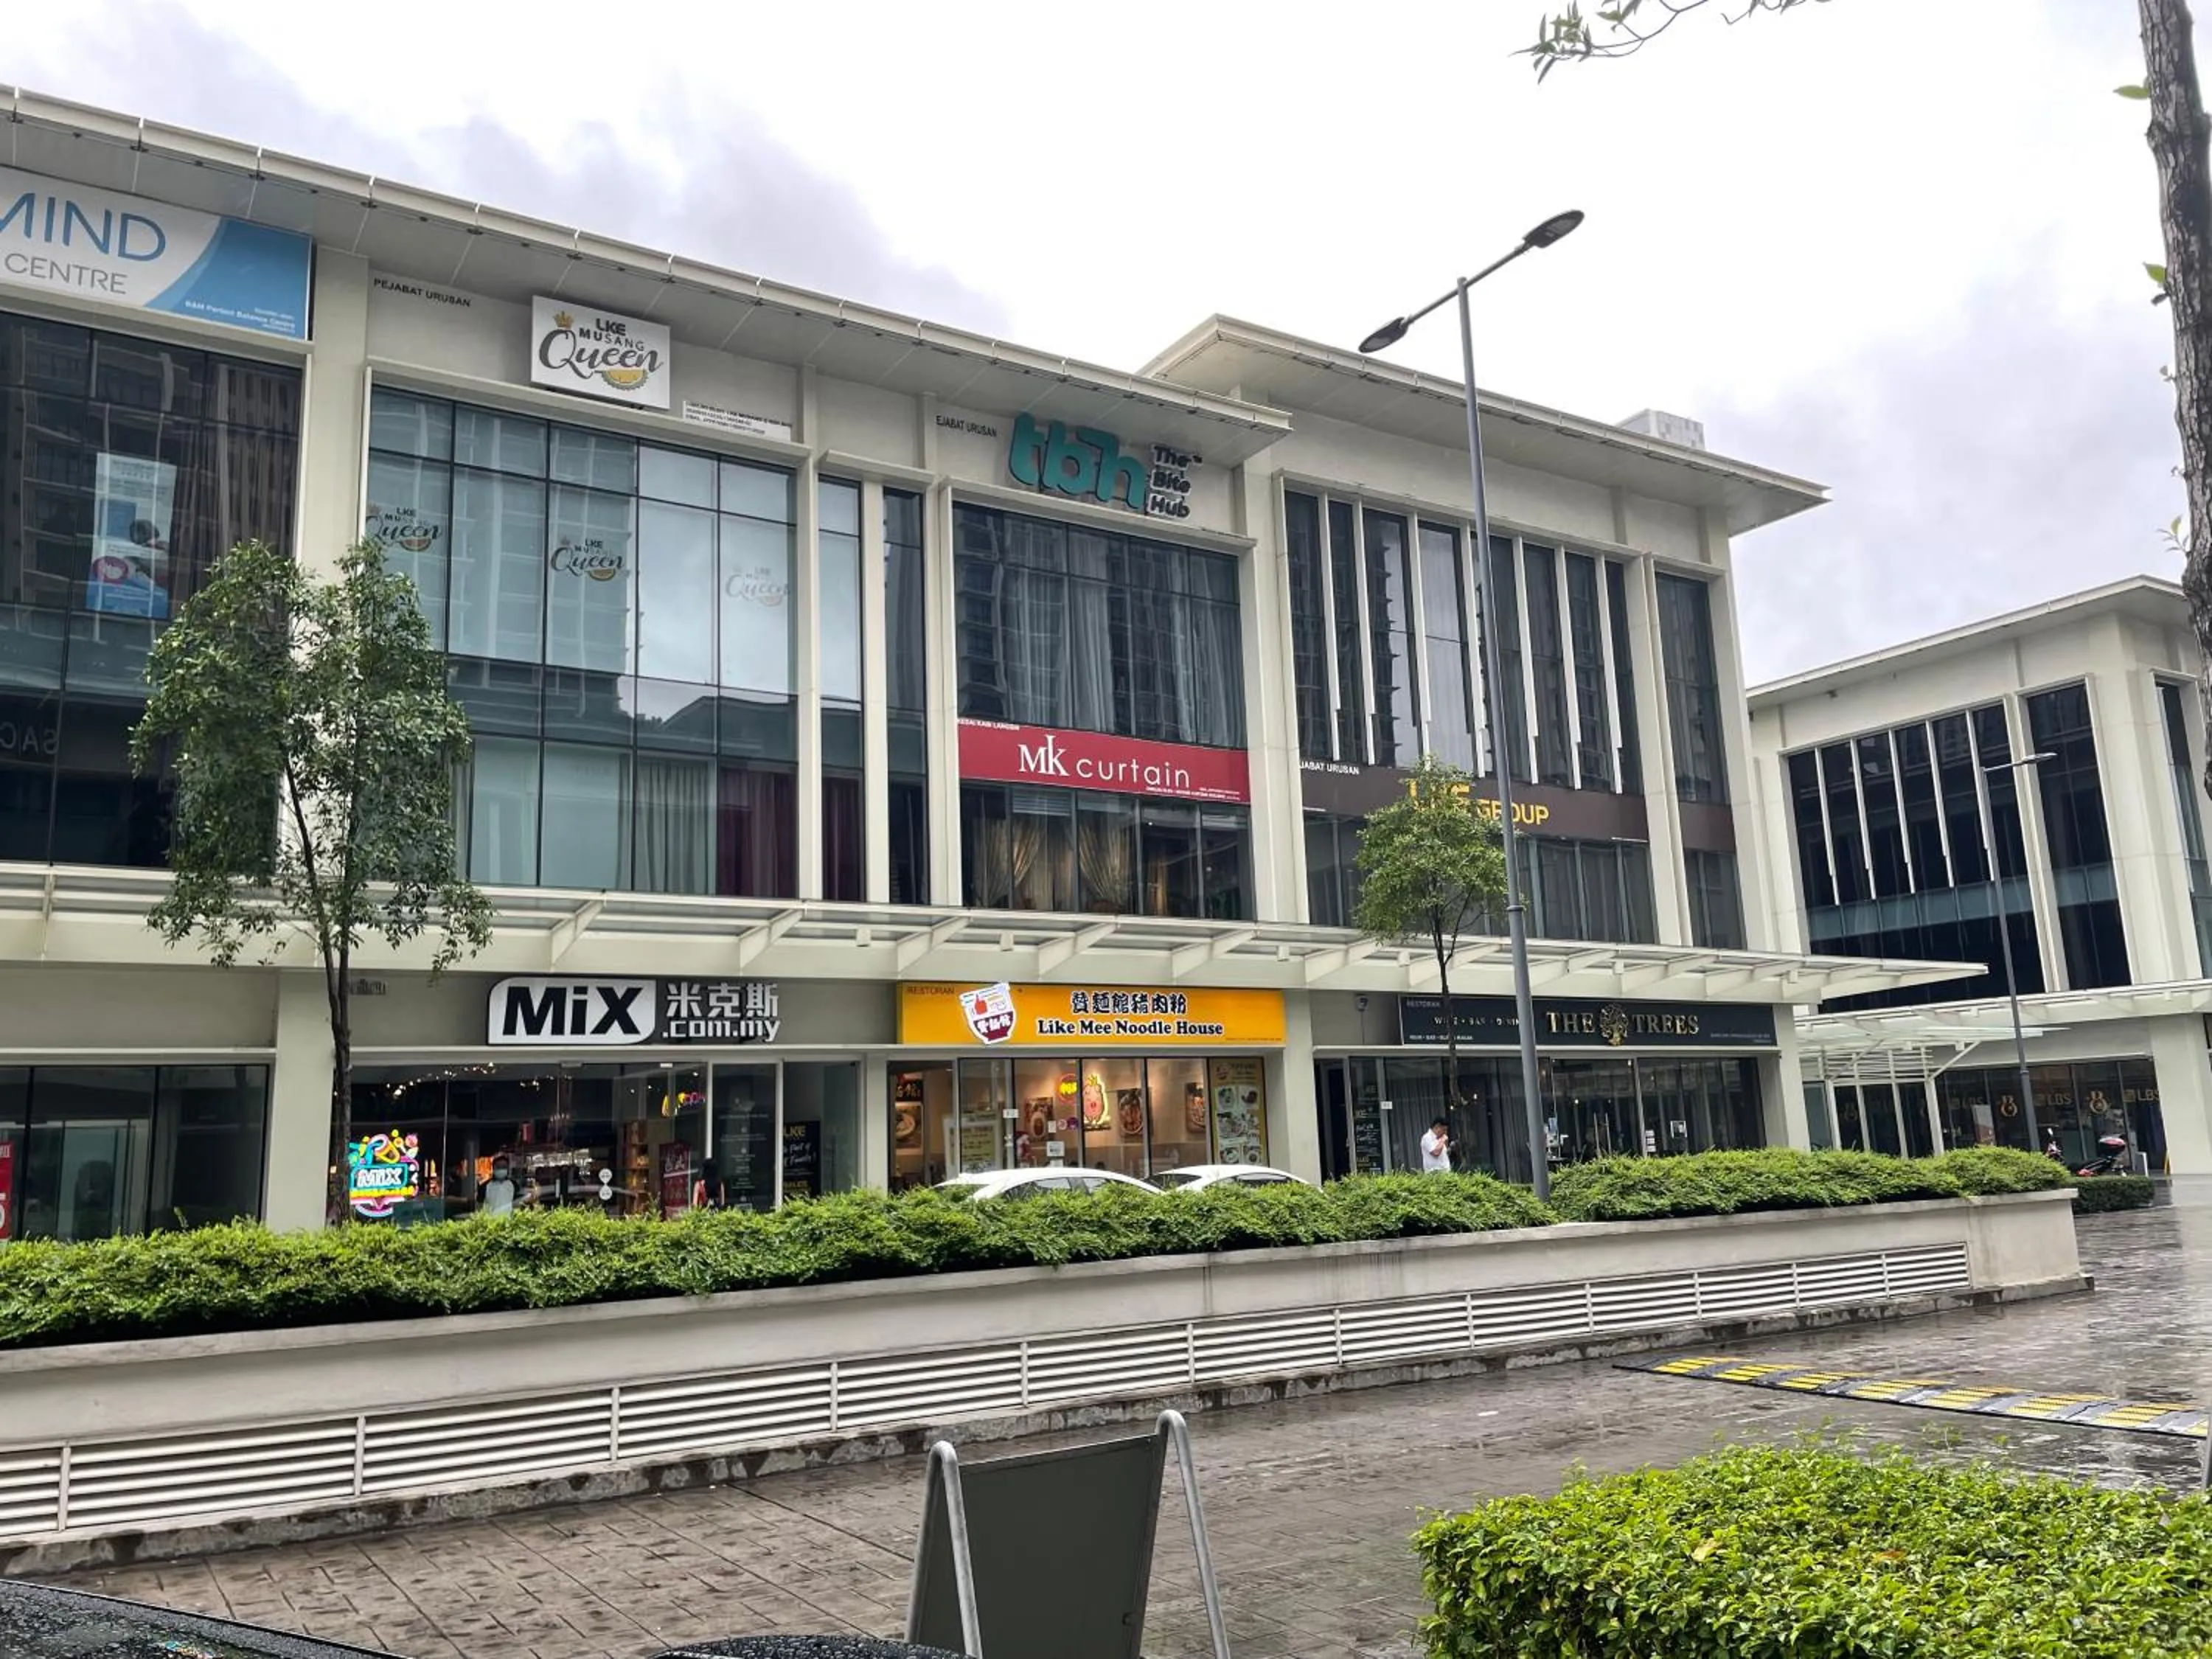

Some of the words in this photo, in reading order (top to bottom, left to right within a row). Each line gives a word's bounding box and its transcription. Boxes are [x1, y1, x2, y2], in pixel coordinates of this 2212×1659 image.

[4, 253, 128, 295] CENTRE
[373, 277, 422, 296] PEJABAT
[425, 290, 471, 307] URUSAN
[579, 327, 644, 352] MUSANG
[596, 318, 626, 336] LKE
[539, 328, 664, 380] Queen
[1152, 445, 1192, 470] The
[1150, 469, 1192, 495] Bite
[1149, 494, 1190, 518] Hub
[366, 515, 441, 547] Queen
[551, 546, 625, 577] Queen
[1077, 758, 1190, 788] curtain
[666, 981, 779, 1018] 米克斯
[907, 986, 954, 995] RESTORAN
[662, 1020, 780, 1042] .com.my
[1037, 1019, 1076, 1034] Like
[1079, 1020, 1112, 1034] Mee
[1116, 1020, 1172, 1034] Noodle
[1176, 1020, 1224, 1036] House
[1546, 1012, 1595, 1033] THE
[1632, 1014, 1700, 1035] TREES
